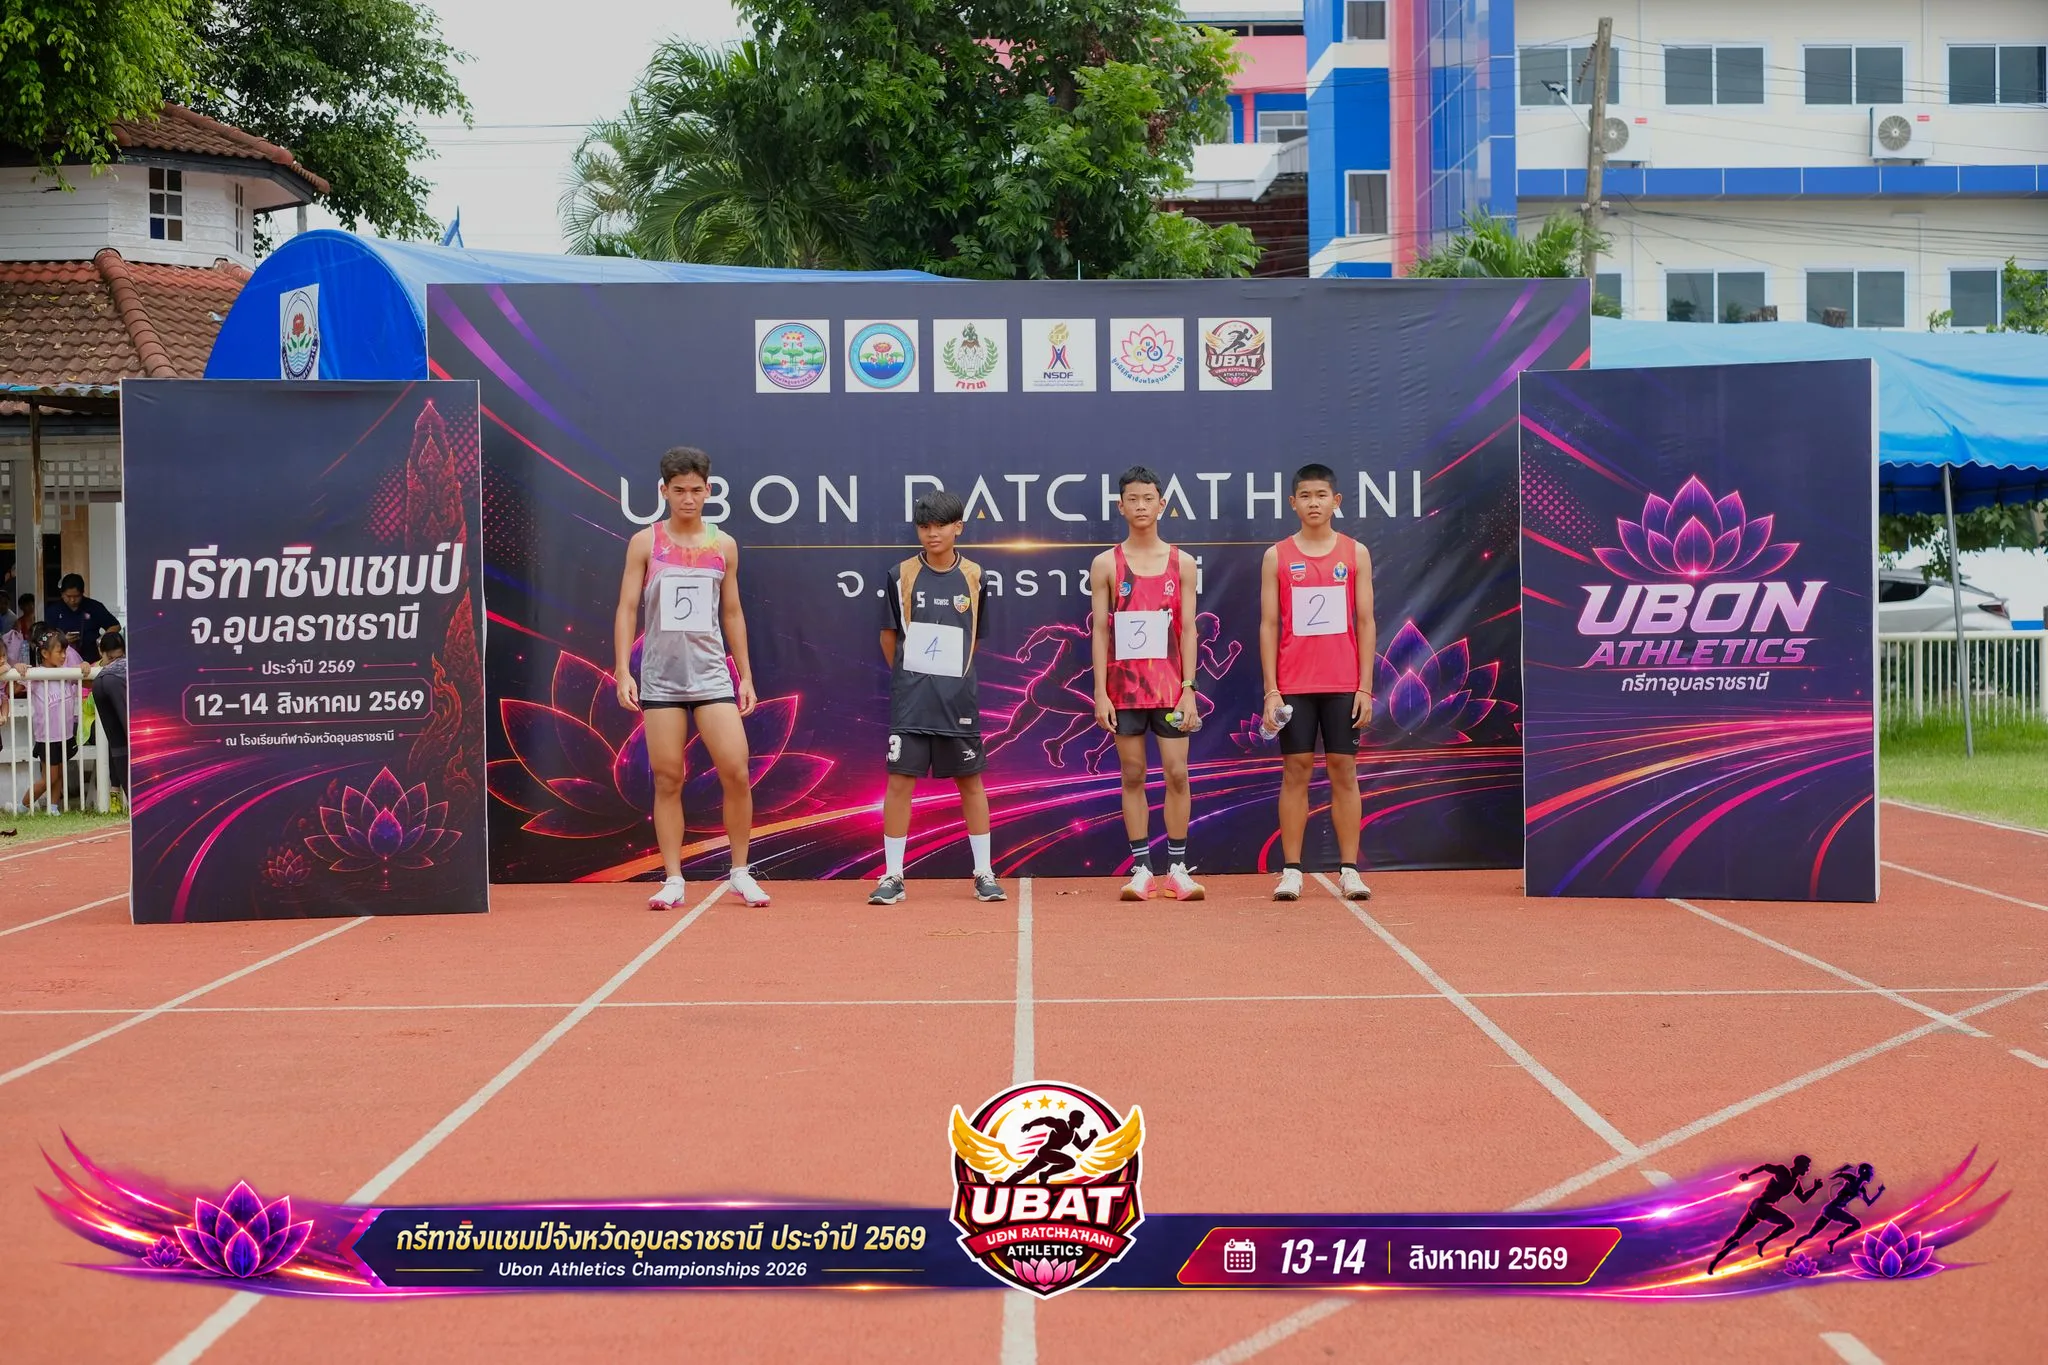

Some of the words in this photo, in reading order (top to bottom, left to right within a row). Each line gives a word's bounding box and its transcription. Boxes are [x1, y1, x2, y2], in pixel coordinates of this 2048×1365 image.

[1210, 354, 1260, 368] UBAT
[1043, 371, 1074, 379] NSDF
[673, 586, 699, 620] 5
[916, 591, 926, 608] 5
[1307, 594, 1330, 626] 2
[1577, 580, 1829, 635] UBON
[1127, 620, 1148, 650] 3
[924, 635, 942, 661] 4
[1578, 637, 1816, 668] ATHLETICS
[262, 658, 314, 675] ประจำปี
[318, 659, 356, 674] 2569
[277, 691, 361, 714] สิงหาคม
[369, 690, 424, 712] 2569
[225, 736, 237, 746] ณ
